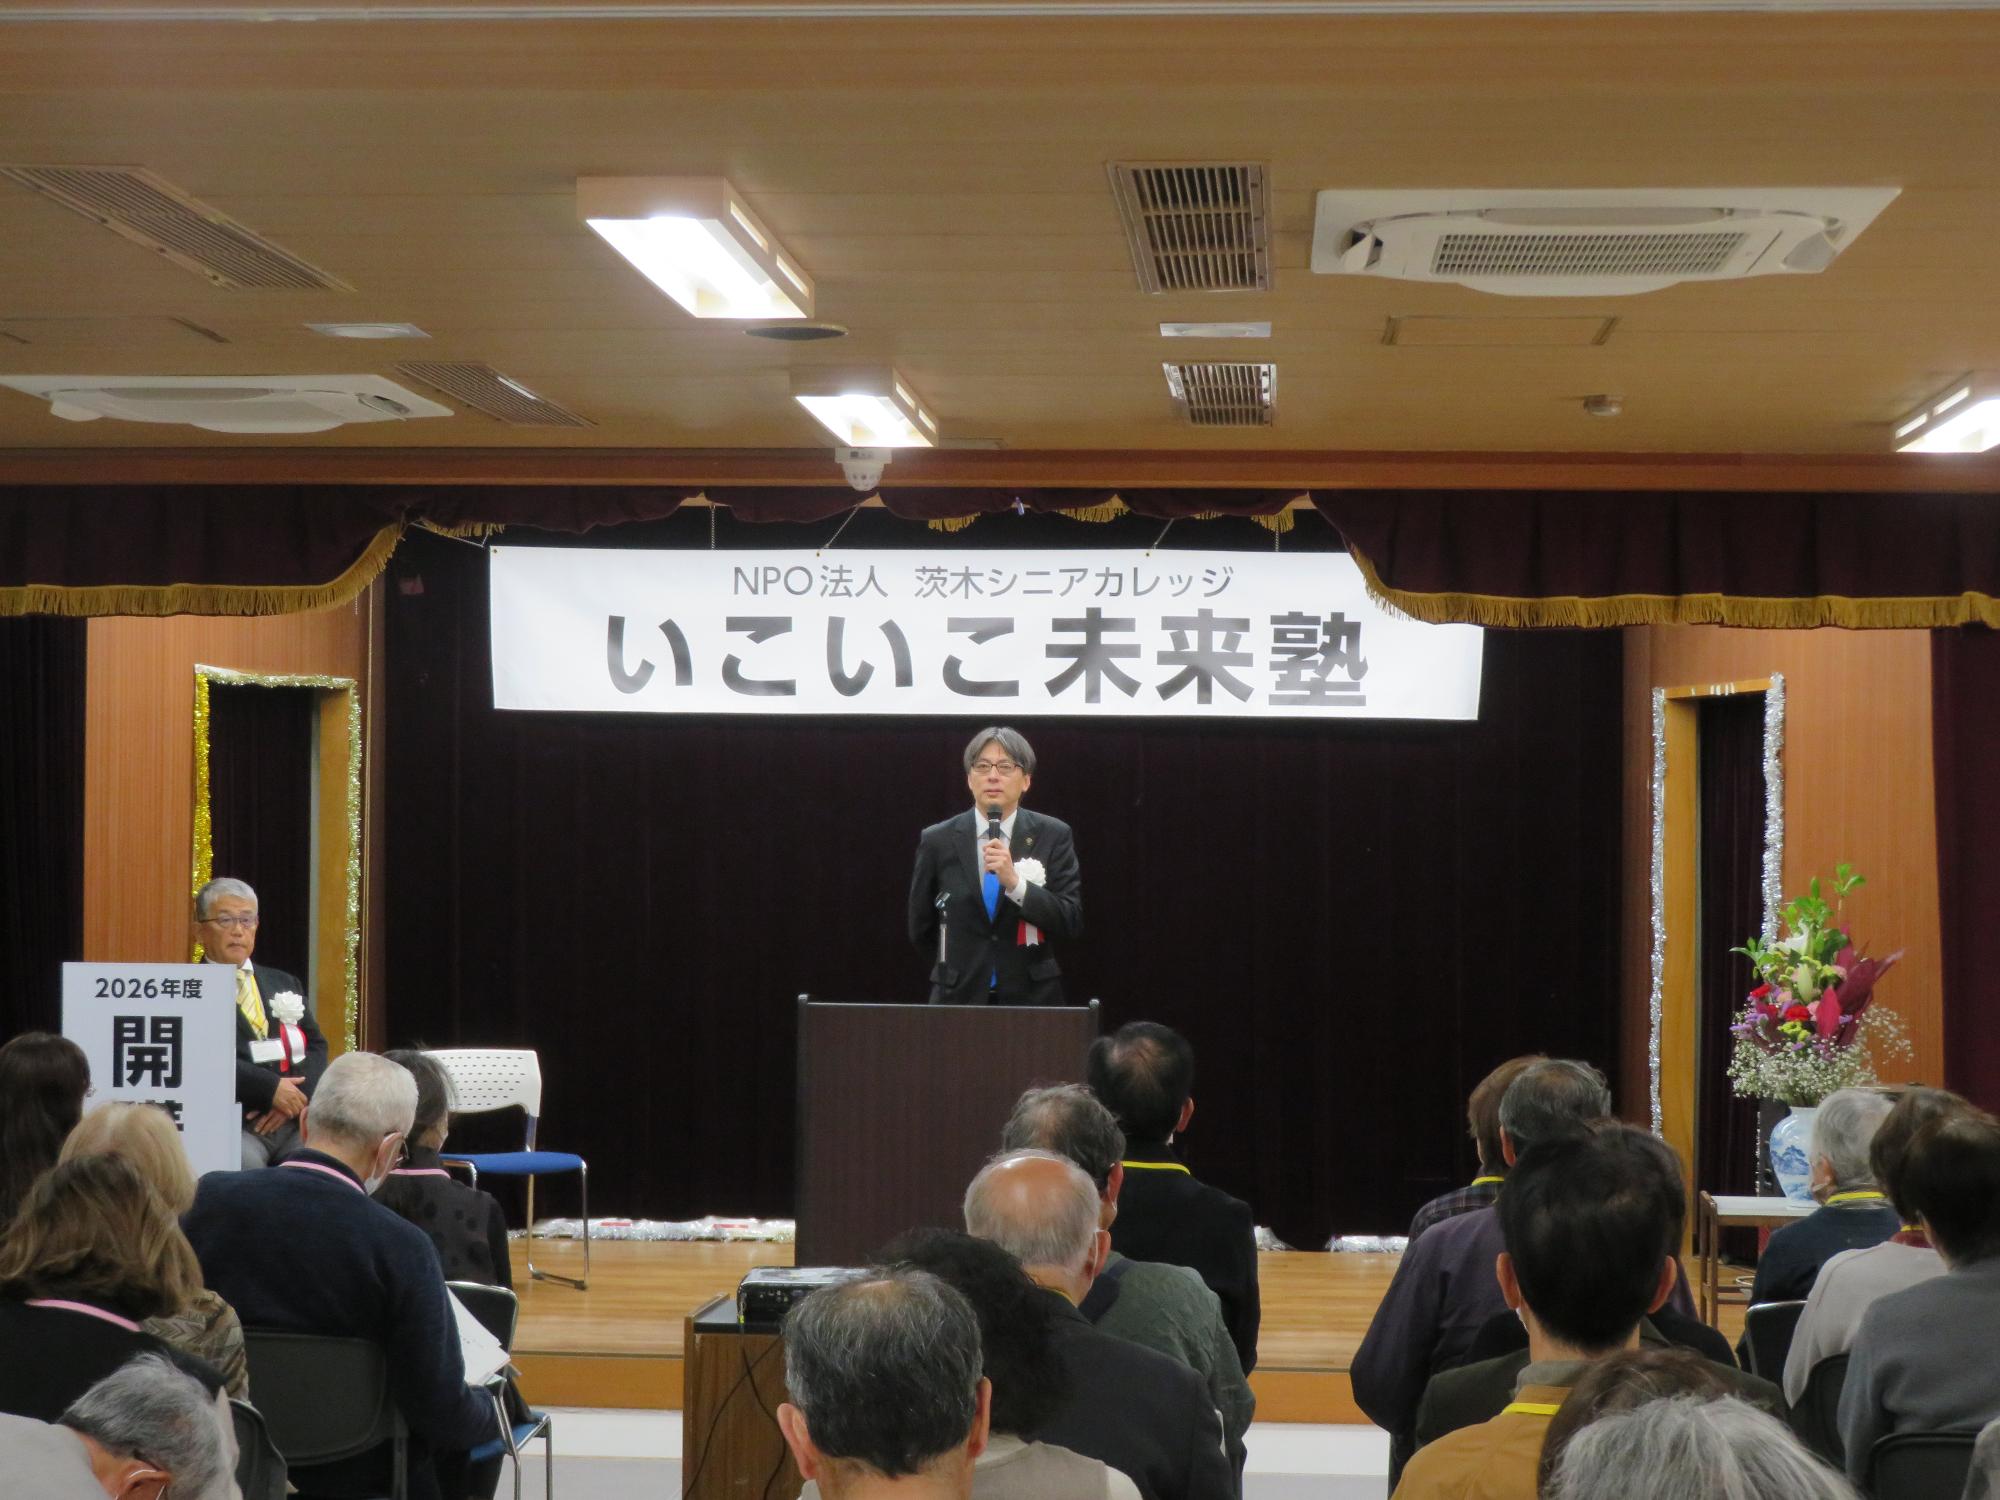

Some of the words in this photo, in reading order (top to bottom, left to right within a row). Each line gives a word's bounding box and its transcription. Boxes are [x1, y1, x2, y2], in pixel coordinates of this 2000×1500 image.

[732, 564, 889, 599] NPO法人
[913, 564, 1235, 599] 茨木シニアカレッジ
[606, 606, 1369, 707] いこいこ未来塾
[95, 978, 203, 999] 2026年度
[113, 1015, 184, 1132] 開
